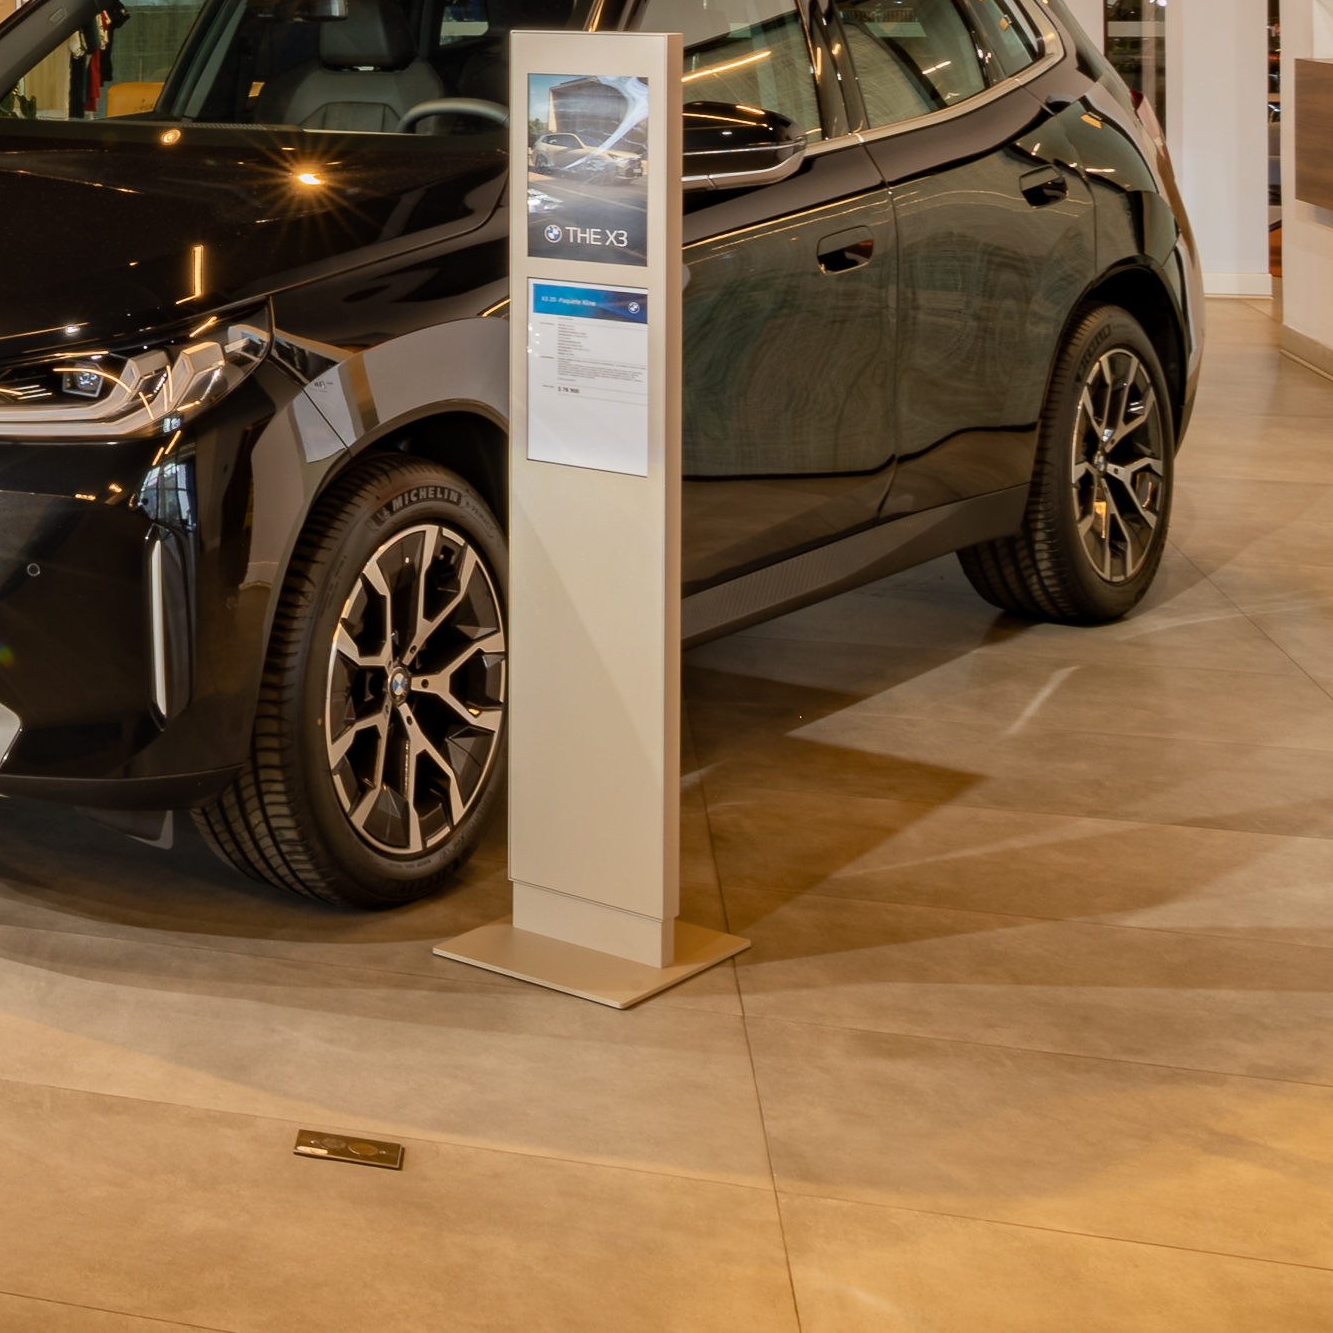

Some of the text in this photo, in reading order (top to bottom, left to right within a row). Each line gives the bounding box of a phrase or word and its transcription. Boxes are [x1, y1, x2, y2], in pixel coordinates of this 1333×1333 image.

[564, 226, 628, 248] THE X3
[392, 487, 460, 512] MICHELIN
